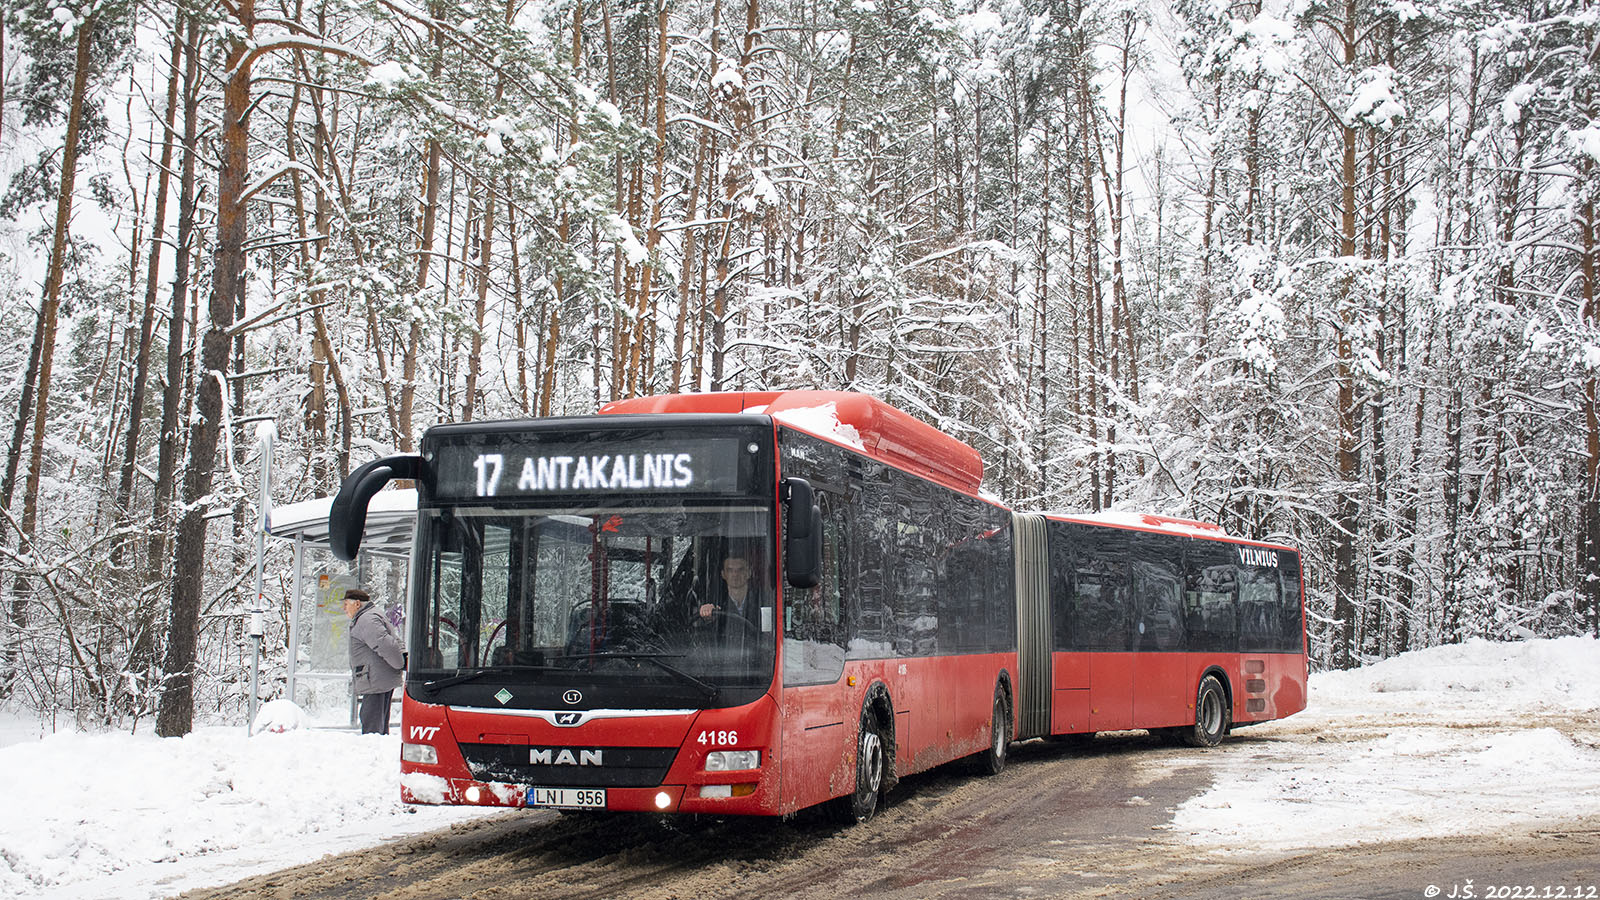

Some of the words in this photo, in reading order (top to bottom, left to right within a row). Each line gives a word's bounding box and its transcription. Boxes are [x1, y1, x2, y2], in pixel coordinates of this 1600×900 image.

[473, 454, 503, 496] 17
[518, 453, 693, 490] ANTAKALNIS
[1238, 547, 1278, 568] VILNIUS
[567, 693, 579, 701] LT
[697, 730, 738, 745] 4186
[529, 749, 602, 766] MAN
[536, 789, 564, 805] LNI
[577, 790, 603, 805] 956
